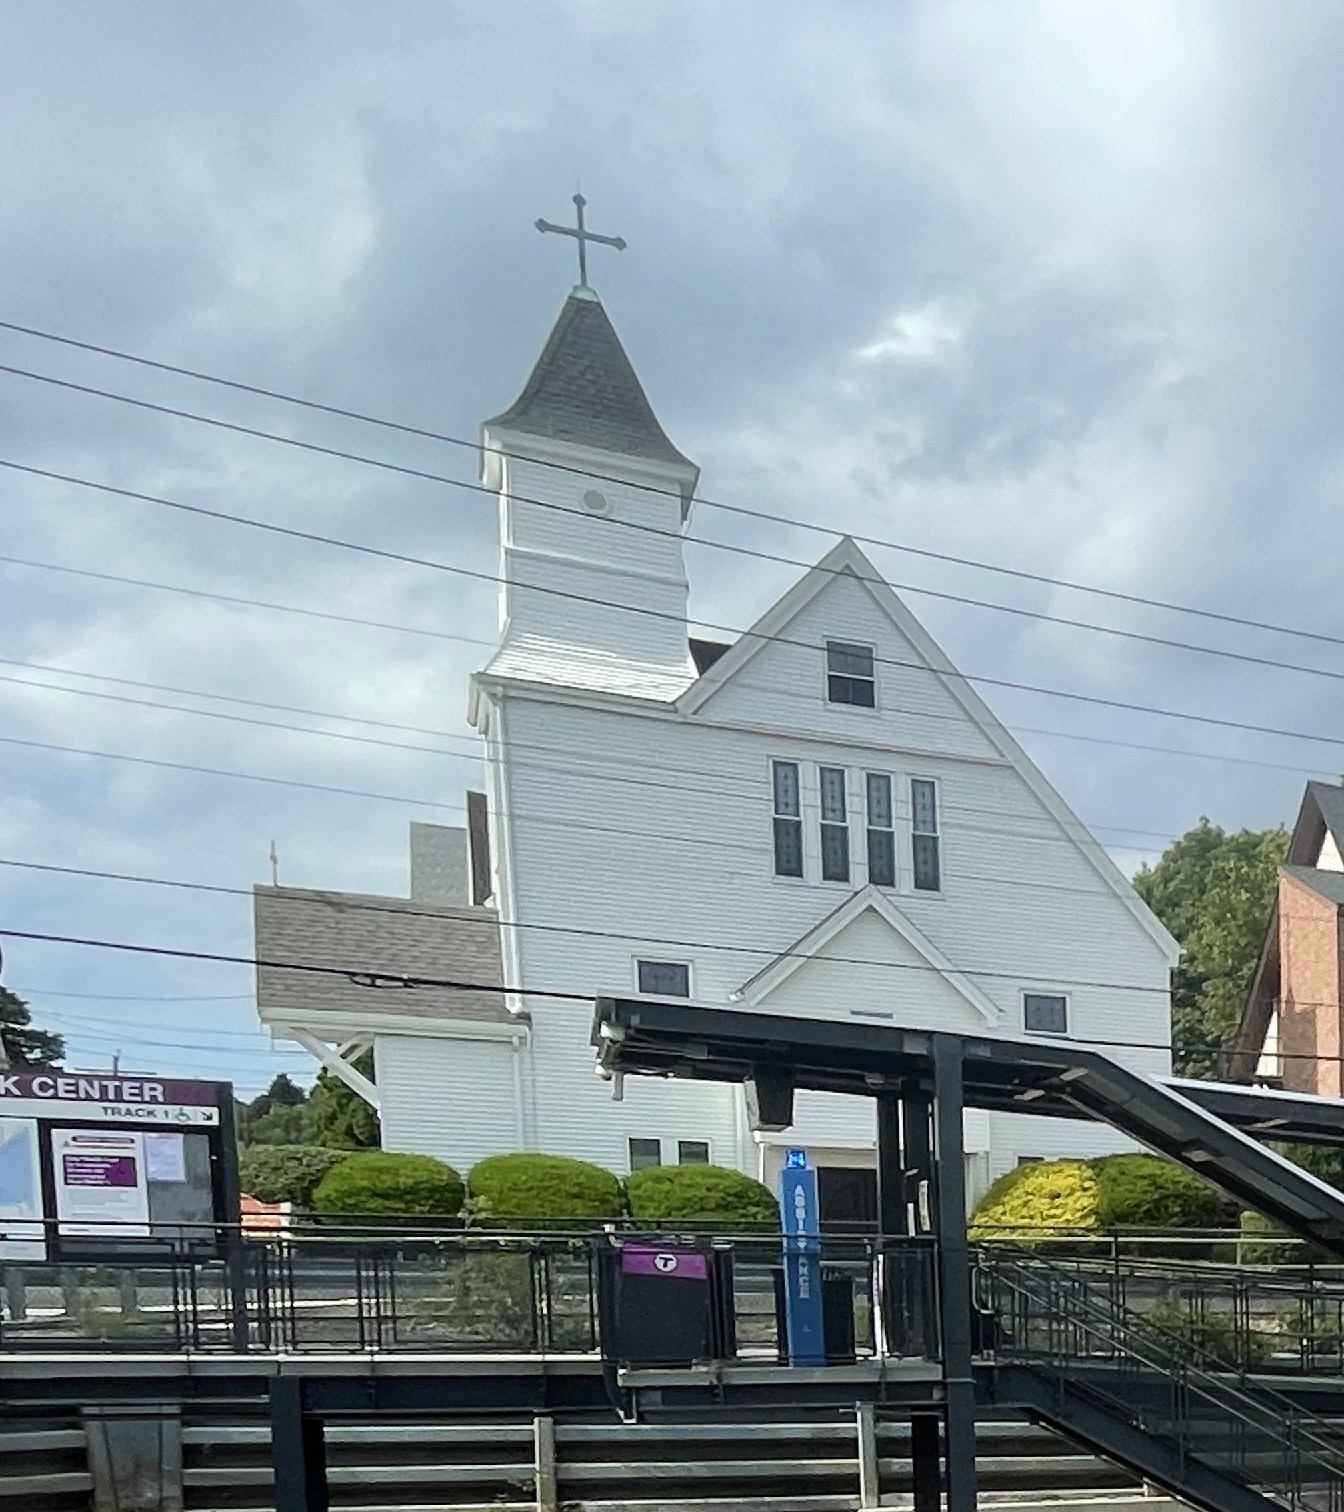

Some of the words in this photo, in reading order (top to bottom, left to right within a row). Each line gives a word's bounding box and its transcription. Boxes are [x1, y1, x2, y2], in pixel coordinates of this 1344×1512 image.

[31, 1076, 164, 1102] CENTER
[101, 1106, 157, 1118] TRACK
[163, 1108, 169, 1118] 1
